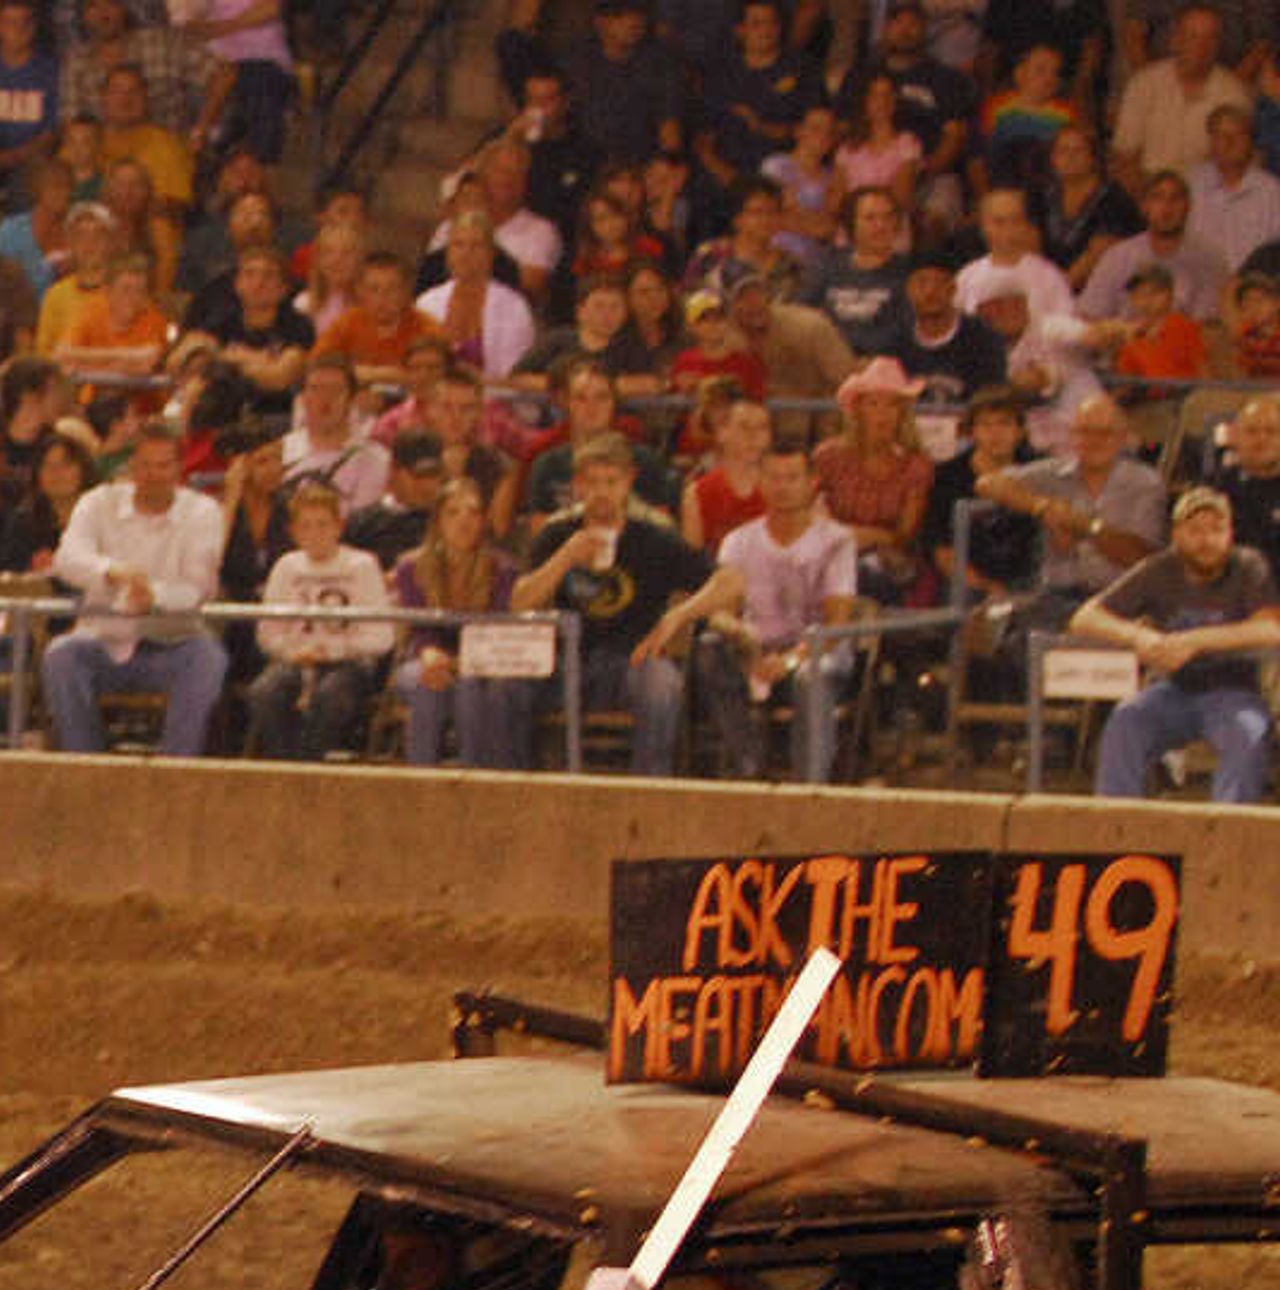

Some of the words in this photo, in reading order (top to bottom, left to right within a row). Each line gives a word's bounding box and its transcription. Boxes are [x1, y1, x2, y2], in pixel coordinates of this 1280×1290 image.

[681, 858, 806, 973] ASK
[806, 855, 930, 965] THE
[1005, 854, 1180, 1042] 49
